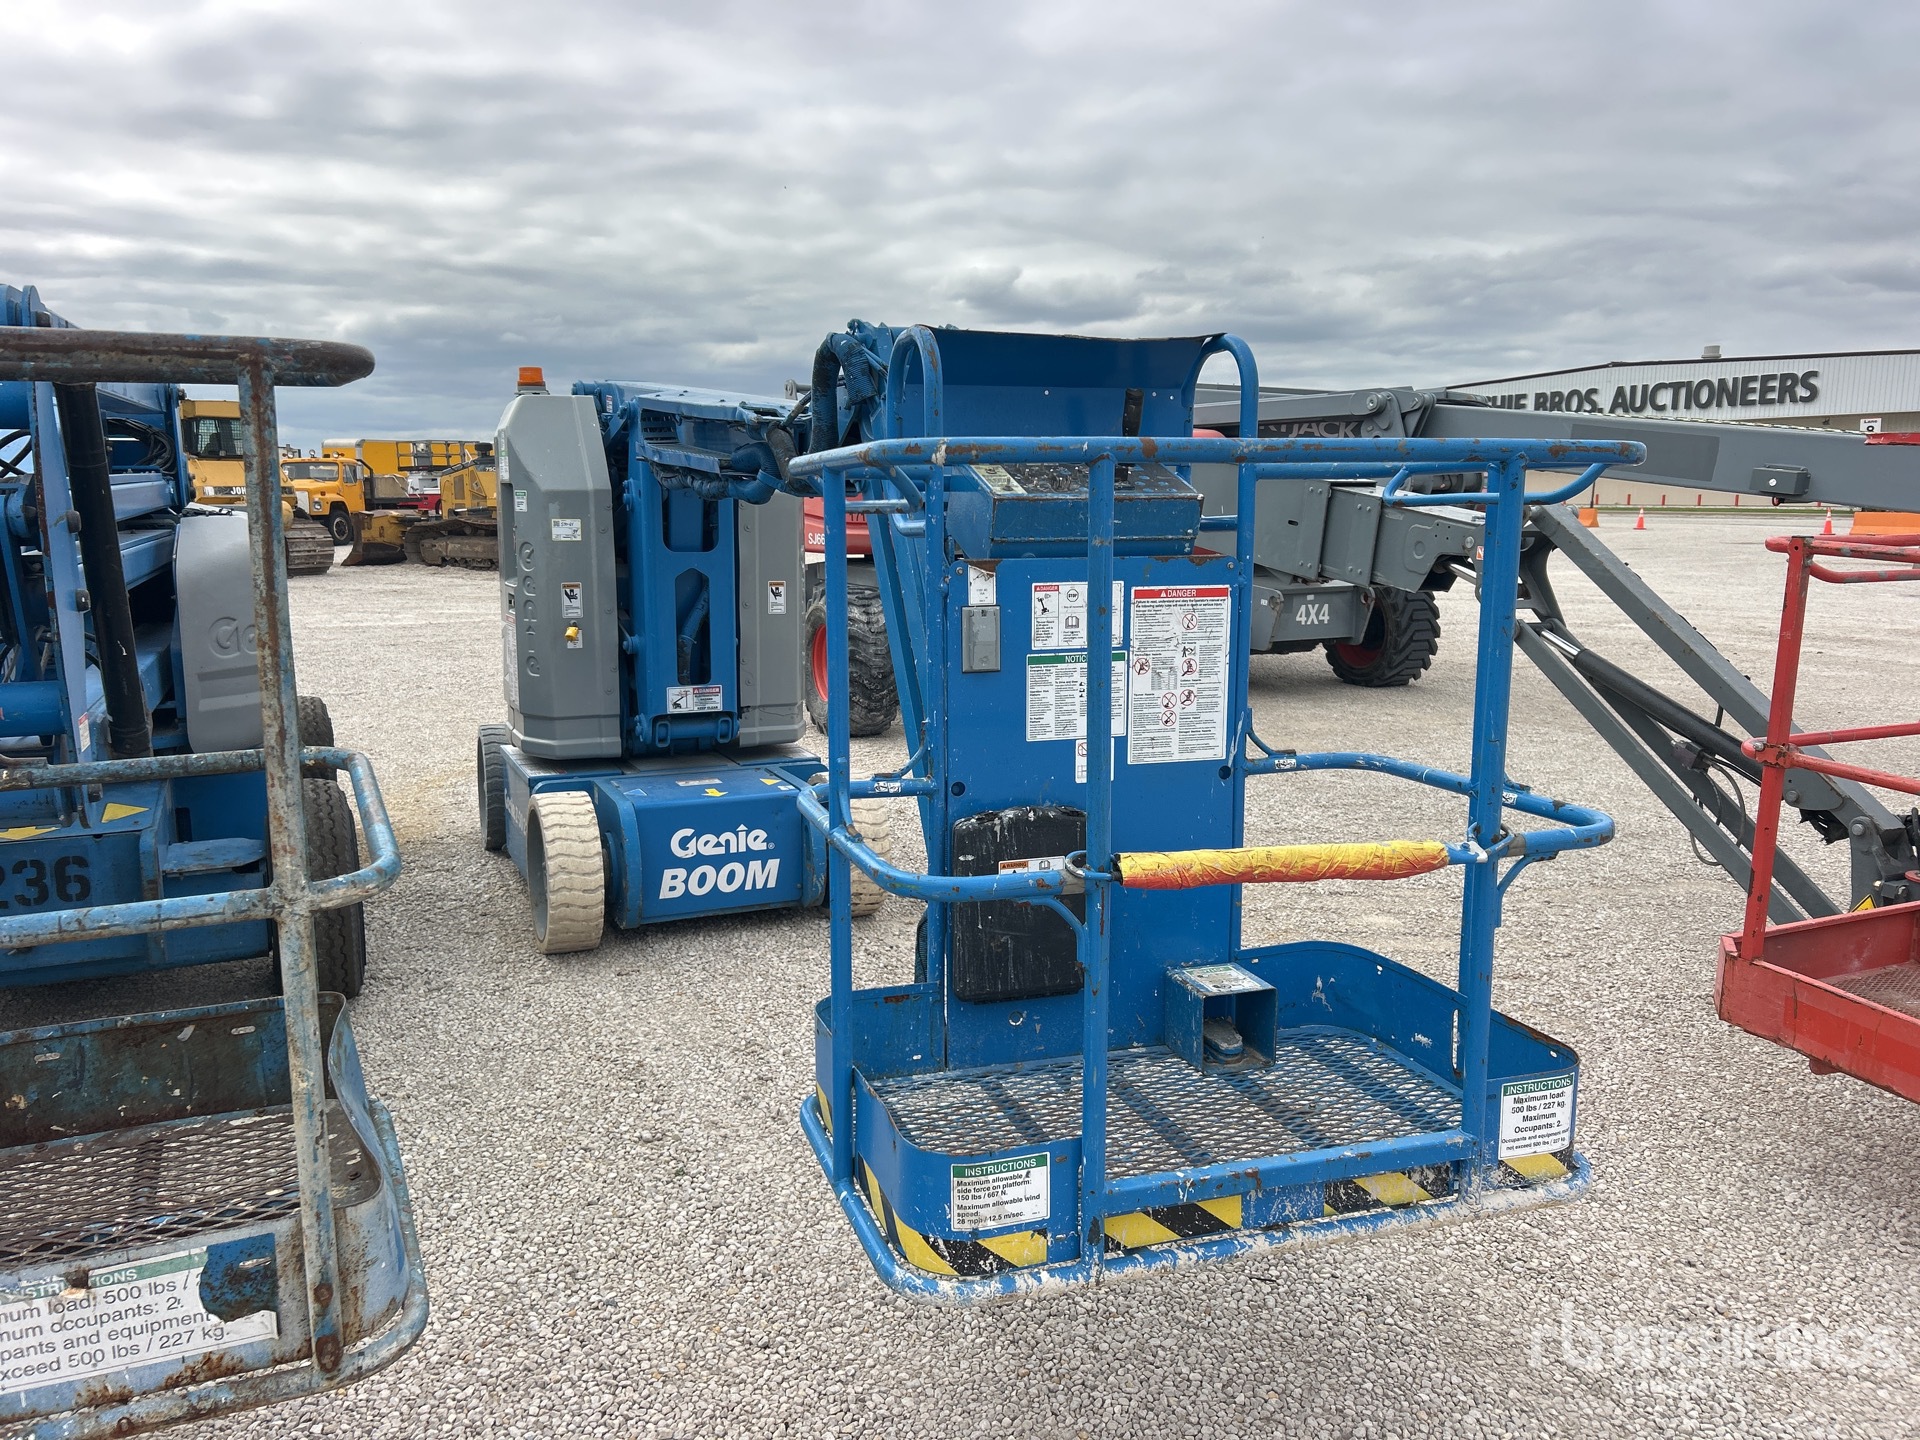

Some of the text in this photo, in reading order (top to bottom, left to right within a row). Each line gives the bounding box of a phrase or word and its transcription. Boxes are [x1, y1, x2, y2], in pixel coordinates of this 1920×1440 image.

[1534, 388, 1604, 413] BROS.
[1608, 370, 1819, 413] AUCTIONEERS
[231, 486, 247, 495] JOH
[808, 532, 825, 545] SJ66
[1167, 589, 1197, 598] DANGER
[1296, 604, 1330, 625] 4X4
[1065, 655, 1088, 663] NOTIC
[659, 858, 780, 899] BOOM
[1506, 1078, 1571, 1095] INSTRUCTIONS
[1513, 1094, 1548, 1105] Maximum
[1512, 1106, 1524, 1114] 500
[1523, 1112, 1556, 1122] Maximum
[1514, 1122, 1555, 1133] Occupants:
[965, 1159, 1036, 1176] INSTRUCTIONS
[957, 1173, 1023, 1187] Maximum allowable
[1002, 1179, 1032, 1189] platform:
[992, 1197, 1023, 1207] allowable
[957, 1210, 980, 1218] speed:
[989, 1214, 1002, 1222] 12.5
[103, 1285, 142, 1305] 500
[149, 1277, 177, 1296] lbs
[50, 1302, 159, 1332] occupants:
[63, 1331, 100, 1350] and
[107, 1311, 212, 1341] equipment
[0, 1357, 62, 1382] xceed
[68, 1350, 105, 1368] 500
[112, 1341, 140, 1358] lbs
[159, 1329, 195, 1349] 227
[202, 1324, 230, 1341] kg.
